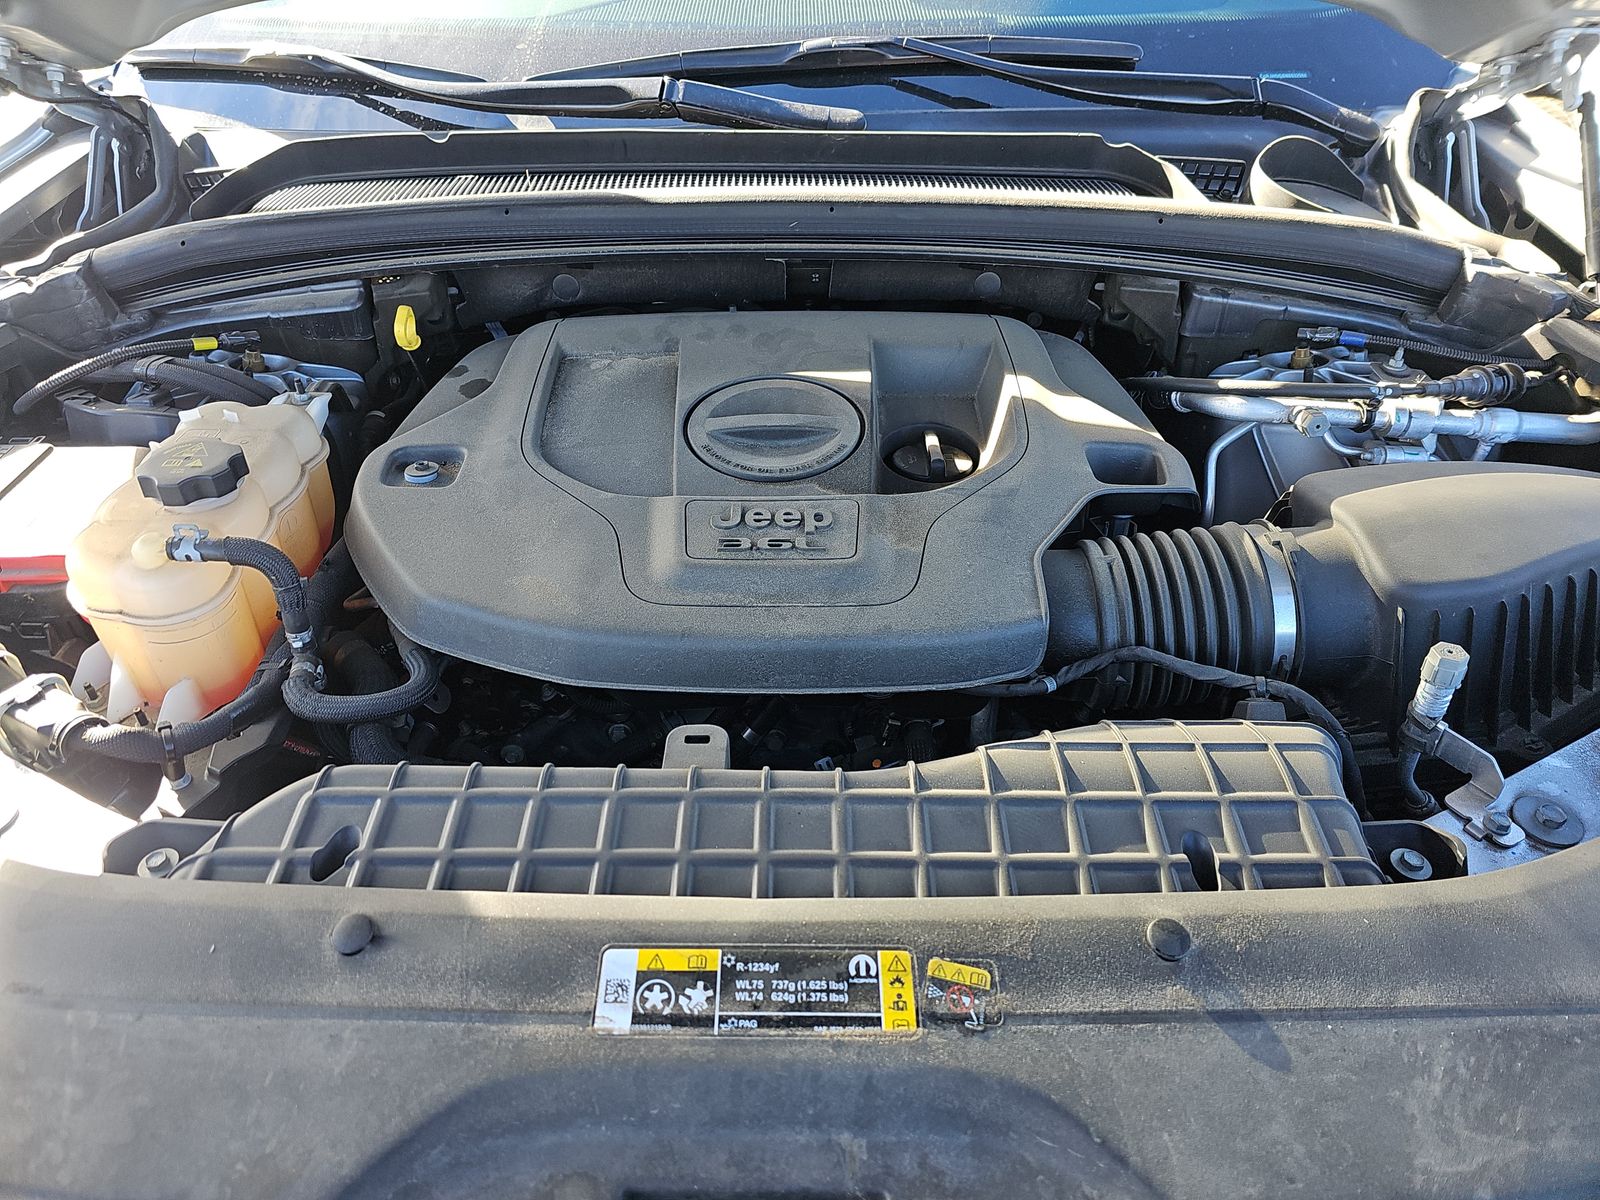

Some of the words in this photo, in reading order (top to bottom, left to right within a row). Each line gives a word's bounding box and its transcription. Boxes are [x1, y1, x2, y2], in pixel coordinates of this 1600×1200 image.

[710, 503, 833, 536] Jeep
[717, 537, 827, 553] 3.6L
[736, 962, 780, 974] R-1234yf
[735, 980, 765, 990] WL75
[771, 980, 796, 992] 737g
[797, 980, 827, 991] (1.625
[828, 980, 849, 992] lbs)
[735, 991, 764, 1002] WL74
[770, 991, 796, 1004] 624g
[797, 992, 828, 1003] (1.375
[829, 992, 849, 1004] lbs)
[738, 1019, 758, 1029] PAG
